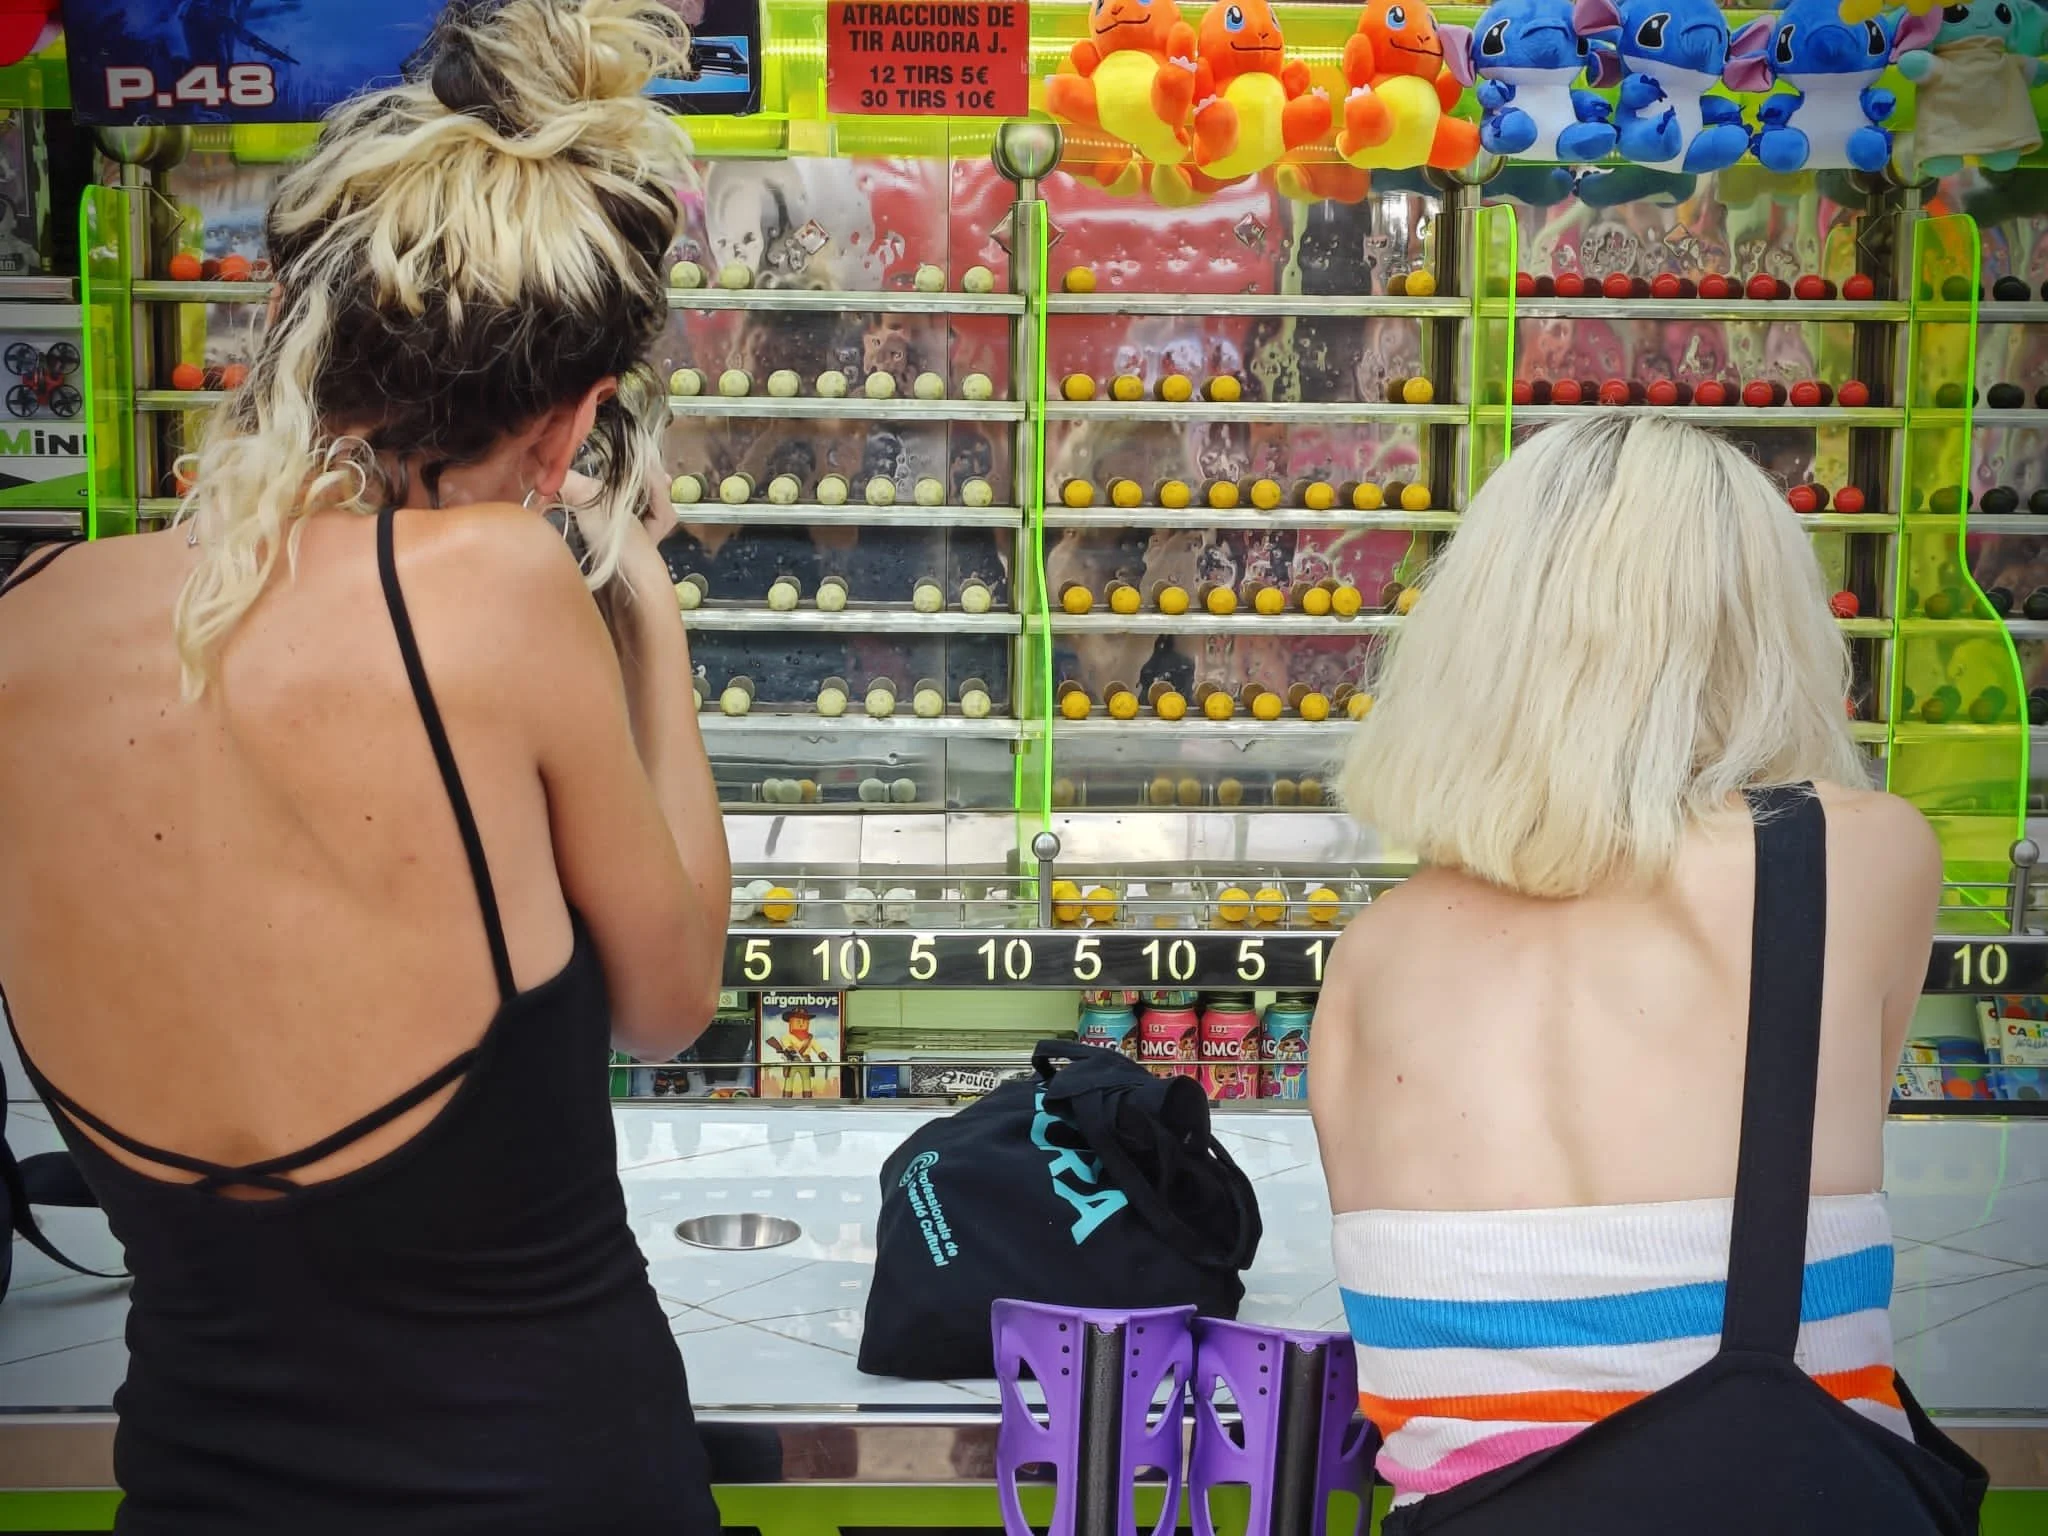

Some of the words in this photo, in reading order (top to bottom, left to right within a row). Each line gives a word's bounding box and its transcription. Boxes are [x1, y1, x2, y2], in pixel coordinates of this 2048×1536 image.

[842, 3, 979, 27] ATRACCIONS
[987, 5, 1015, 27] DE
[849, 30, 884, 52] TIR
[891, 31, 980, 53] AURORA
[987, 32, 1008, 54] J.
[104, 62, 275, 109] P.48
[869, 65, 896, 84] 12
[903, 65, 954, 85] TIRS
[961, 66, 989, 85] 5€
[861, 89, 888, 108] 30
[896, 89, 947, 109] TIRS
[955, 91, 996, 109] 10€
[744, 939, 772, 981] 5
[812, 939, 871, 981] 10
[909, 938, 937, 980] 5
[977, 938, 1033, 981] 10
[1073, 939, 1102, 981] 5
[1142, 939, 1197, 981] 10
[1237, 939, 1266, 981] 5
[1304, 939, 1323, 981] 1
[1953, 943, 2009, 985] 10
[763, 990, 839, 1009] airgamboys
[959, 1073, 995, 1089] POLICE
[920, 1219, 949, 1267] Cultural
[945, 1241, 958, 1257] de
